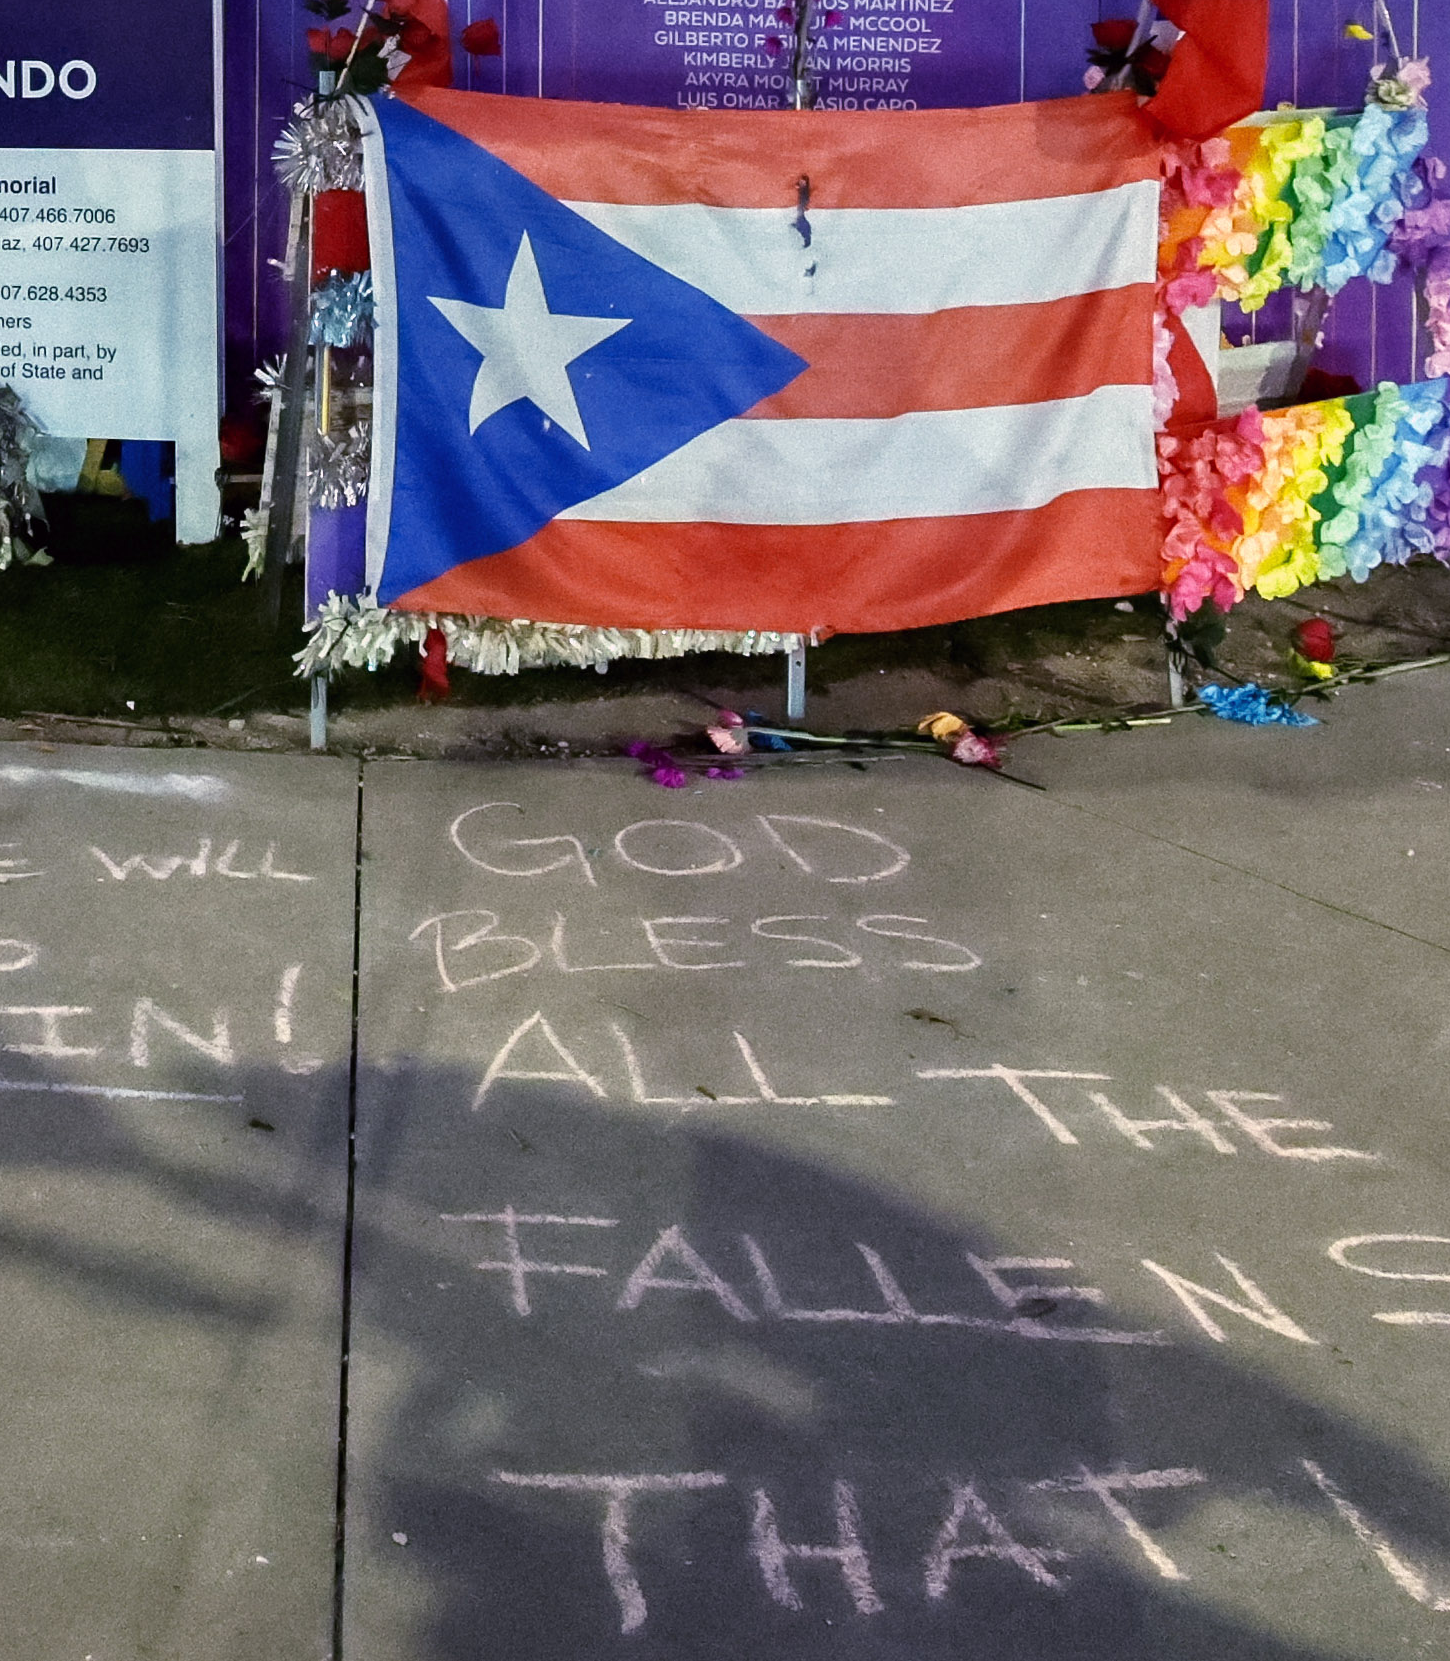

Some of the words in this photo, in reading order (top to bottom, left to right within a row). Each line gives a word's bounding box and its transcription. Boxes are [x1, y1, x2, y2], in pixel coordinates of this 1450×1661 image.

[0, 208, 115, 223] 407.466.7006
[33, 237, 149, 253] 407.427.7693
[0, 363, 16, 379] of
[21, 363, 65, 380] State
[70, 365, 103, 381] and
[32, 342, 47, 357] in
[52, 343, 90, 361] part,
[96, 344, 117, 363] by
[449, 802, 911, 886] GOD
[408, 911, 983, 994] BLESS
[471, 1012, 895, 1110] ALL
[914, 1064, 1383, 1162] THE
[440, 1205, 1320, 1346] FALLEN
[498, 1465, 1211, 1634] THAT
